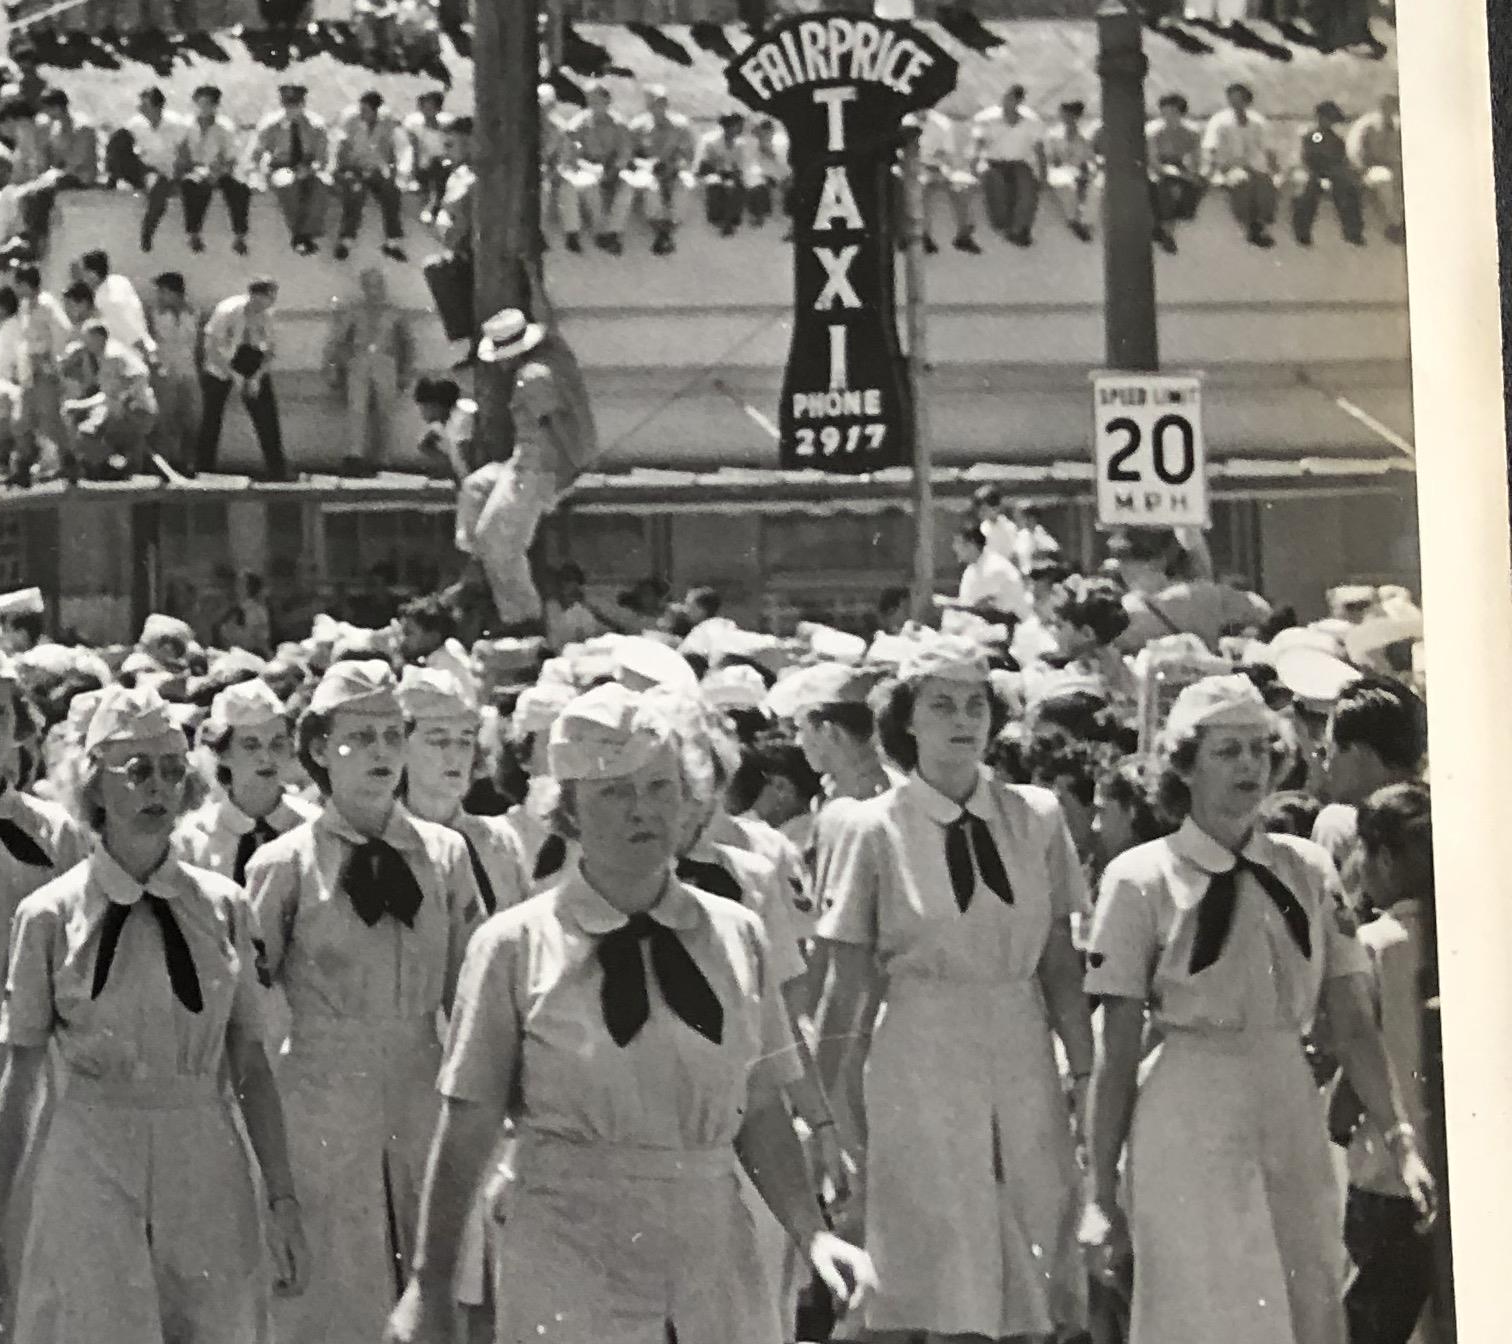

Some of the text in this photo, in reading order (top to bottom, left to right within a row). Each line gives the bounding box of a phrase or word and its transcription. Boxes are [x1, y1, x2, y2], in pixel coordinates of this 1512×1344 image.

[739, 19, 935, 101] FAIRPRICE
[811, 86, 865, 391] TAXI
[792, 388, 883, 419] PHONE
[1099, 387, 1147, 407] SPEED
[1105, 413, 1197, 485] 20
